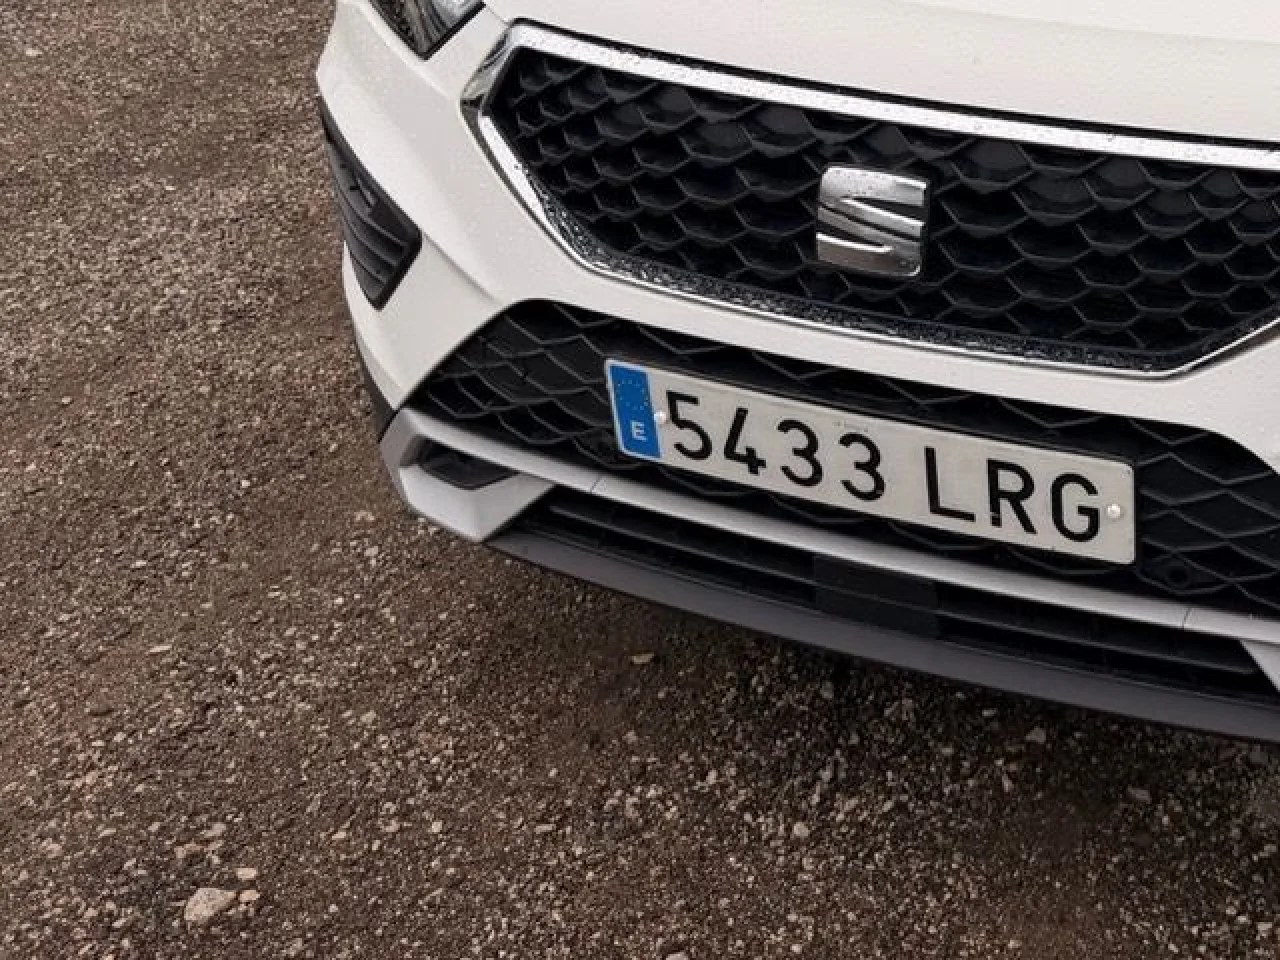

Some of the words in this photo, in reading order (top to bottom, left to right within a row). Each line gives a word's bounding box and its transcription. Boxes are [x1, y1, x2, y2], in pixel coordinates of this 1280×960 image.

[630, 421, 647, 441] E
[665, 390, 887, 503] 5433
[923, 445, 1101, 543] LRG
